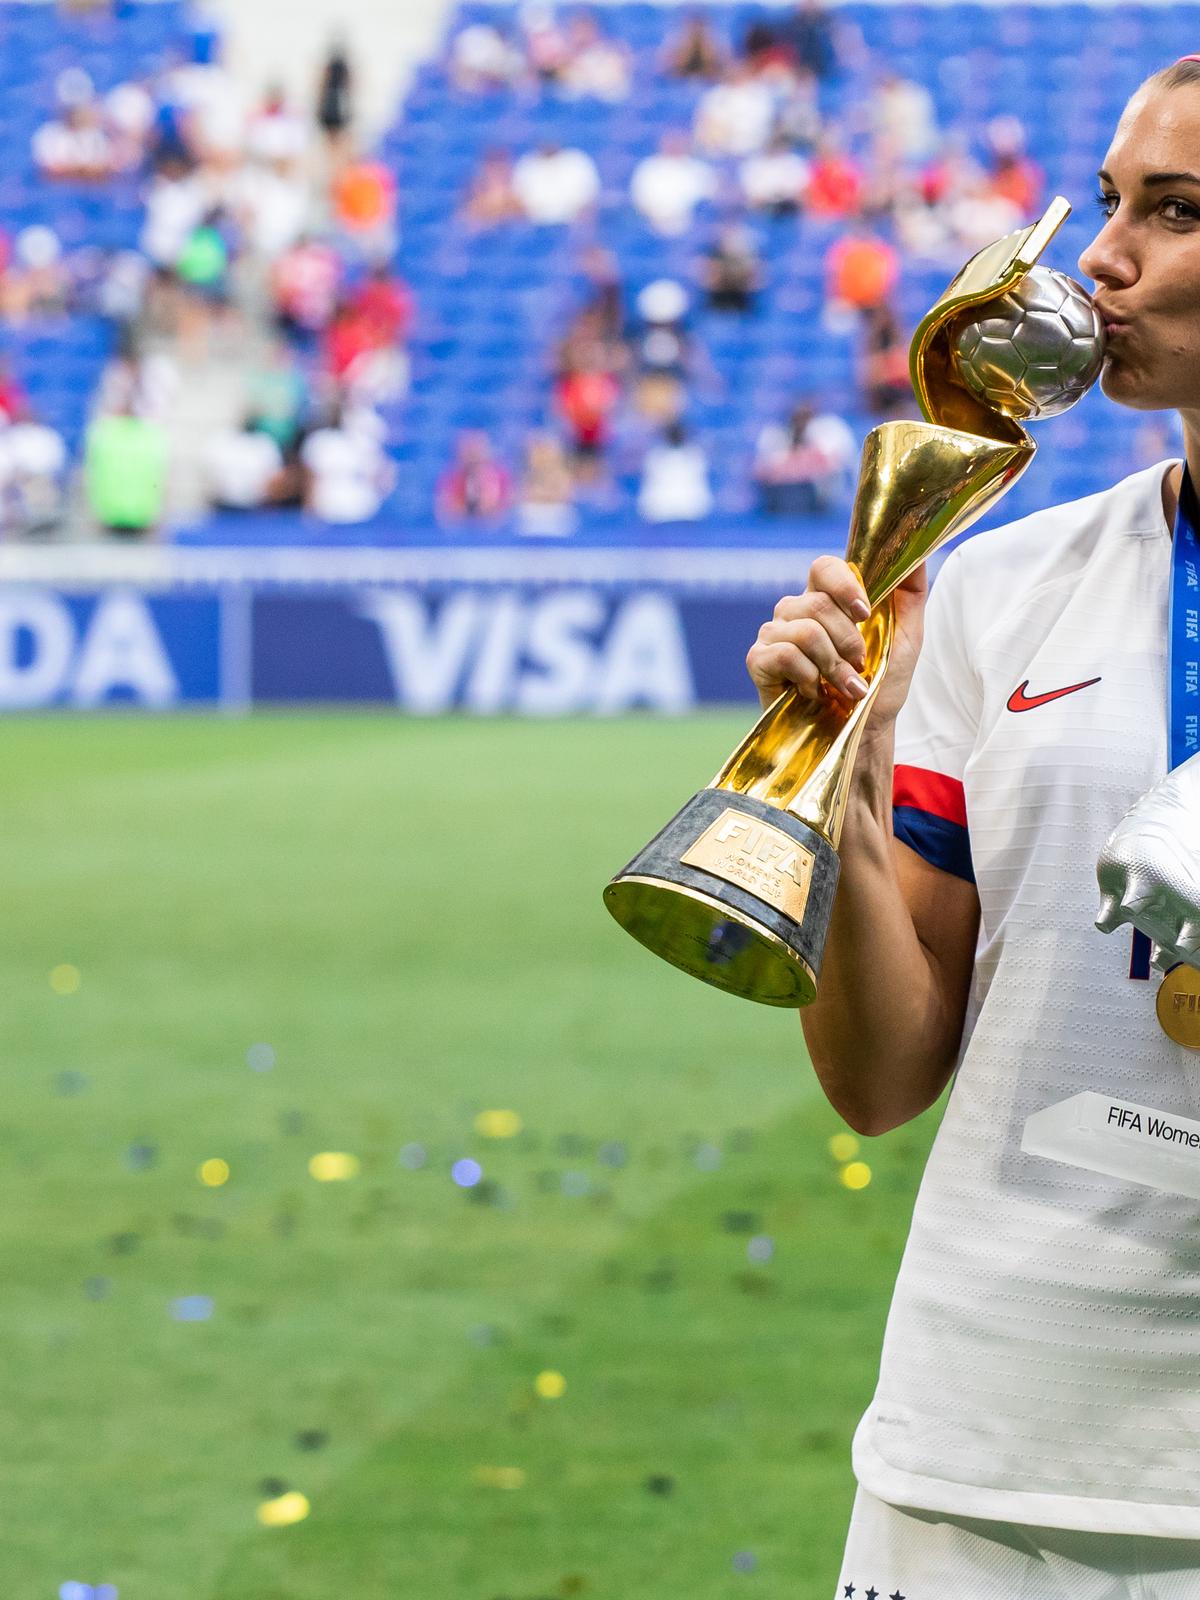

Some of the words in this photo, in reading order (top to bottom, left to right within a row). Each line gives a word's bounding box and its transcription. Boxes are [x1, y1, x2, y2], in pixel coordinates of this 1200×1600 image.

[351, 588, 698, 716] VISA
[714, 820, 802, 888] FIFA
[1107, 1106, 1142, 1133] FIFA
